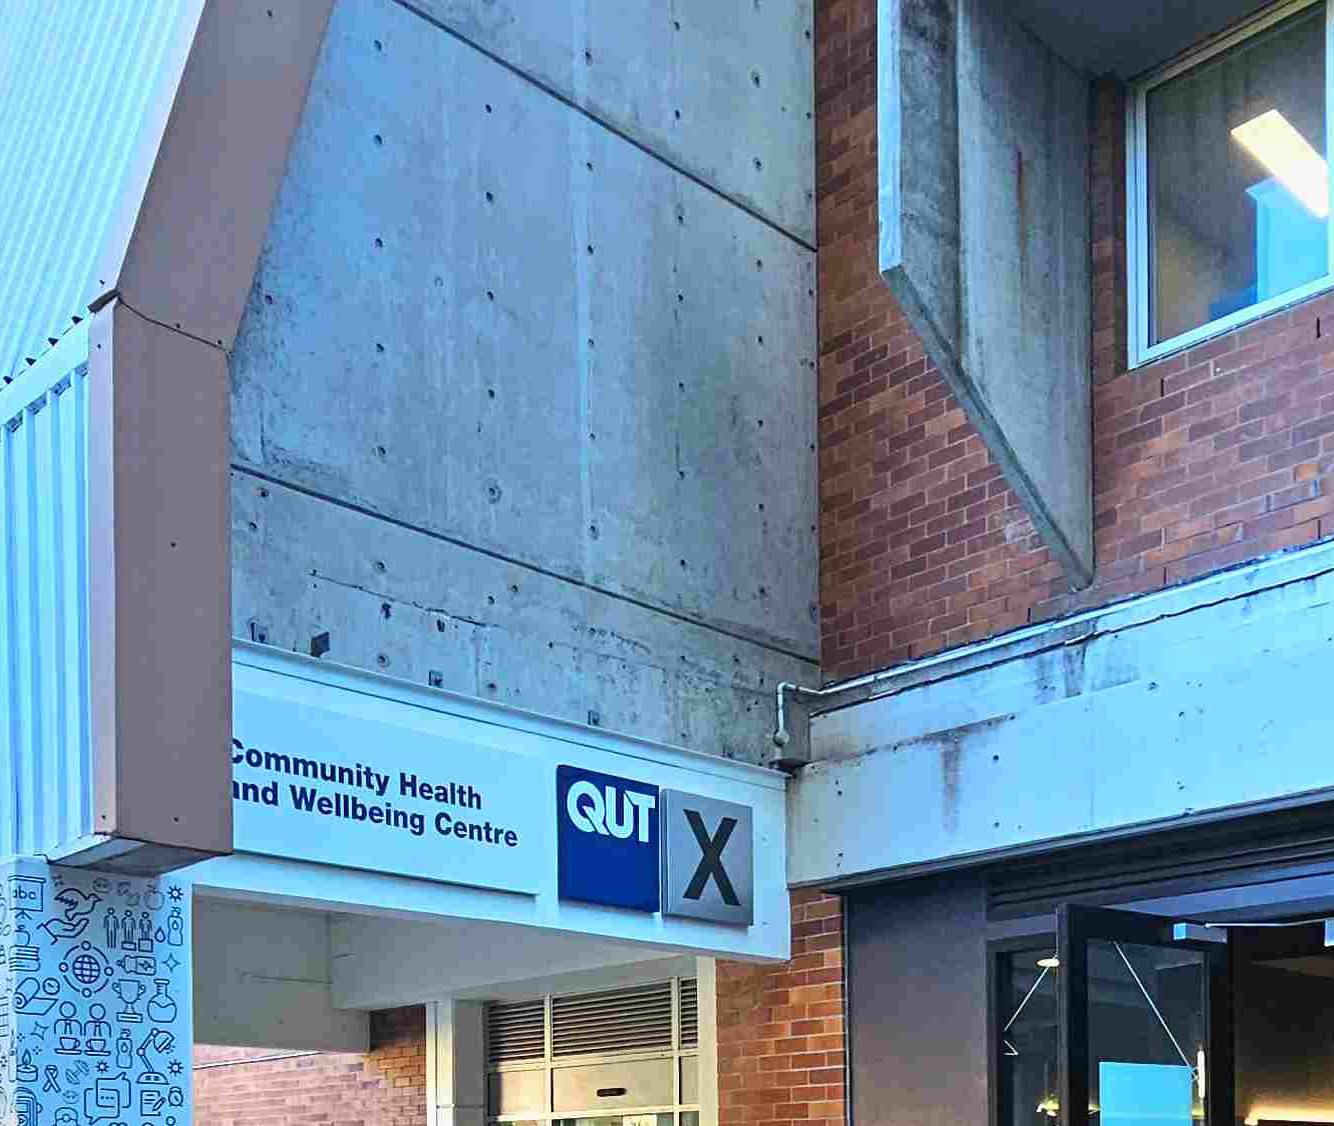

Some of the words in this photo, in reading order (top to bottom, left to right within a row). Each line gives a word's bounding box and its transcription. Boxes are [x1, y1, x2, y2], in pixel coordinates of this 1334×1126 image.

[289, 784, 425, 836] Wellbeing
[435, 812, 518, 847] Centre
[400, 772, 482, 810] Health
[567, 780, 655, 842] QUT
[683, 808, 740, 906] X
